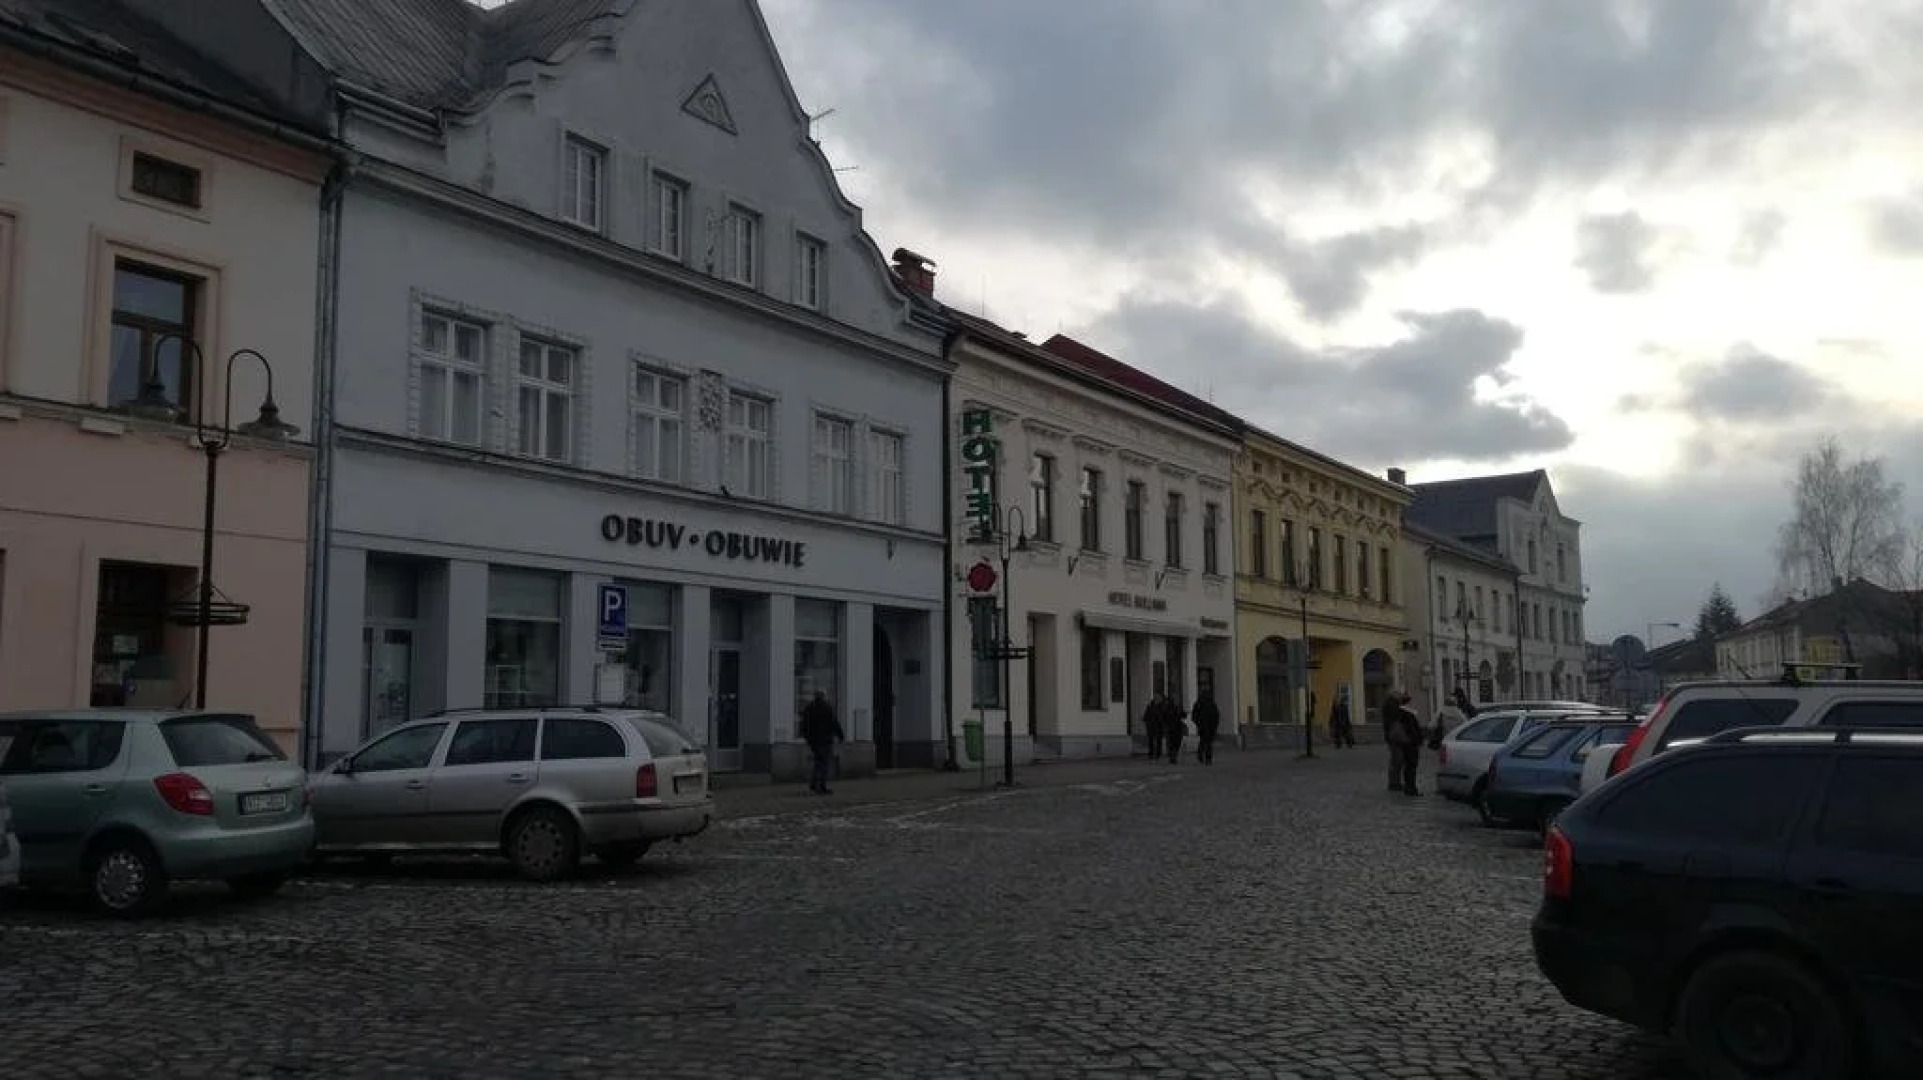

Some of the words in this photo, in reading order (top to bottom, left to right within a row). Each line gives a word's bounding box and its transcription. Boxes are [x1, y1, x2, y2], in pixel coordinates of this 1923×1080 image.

[601, 513, 685, 550] OBUV
[705, 530, 806, 569] OBUWIE
[604, 590, 622, 621] P
